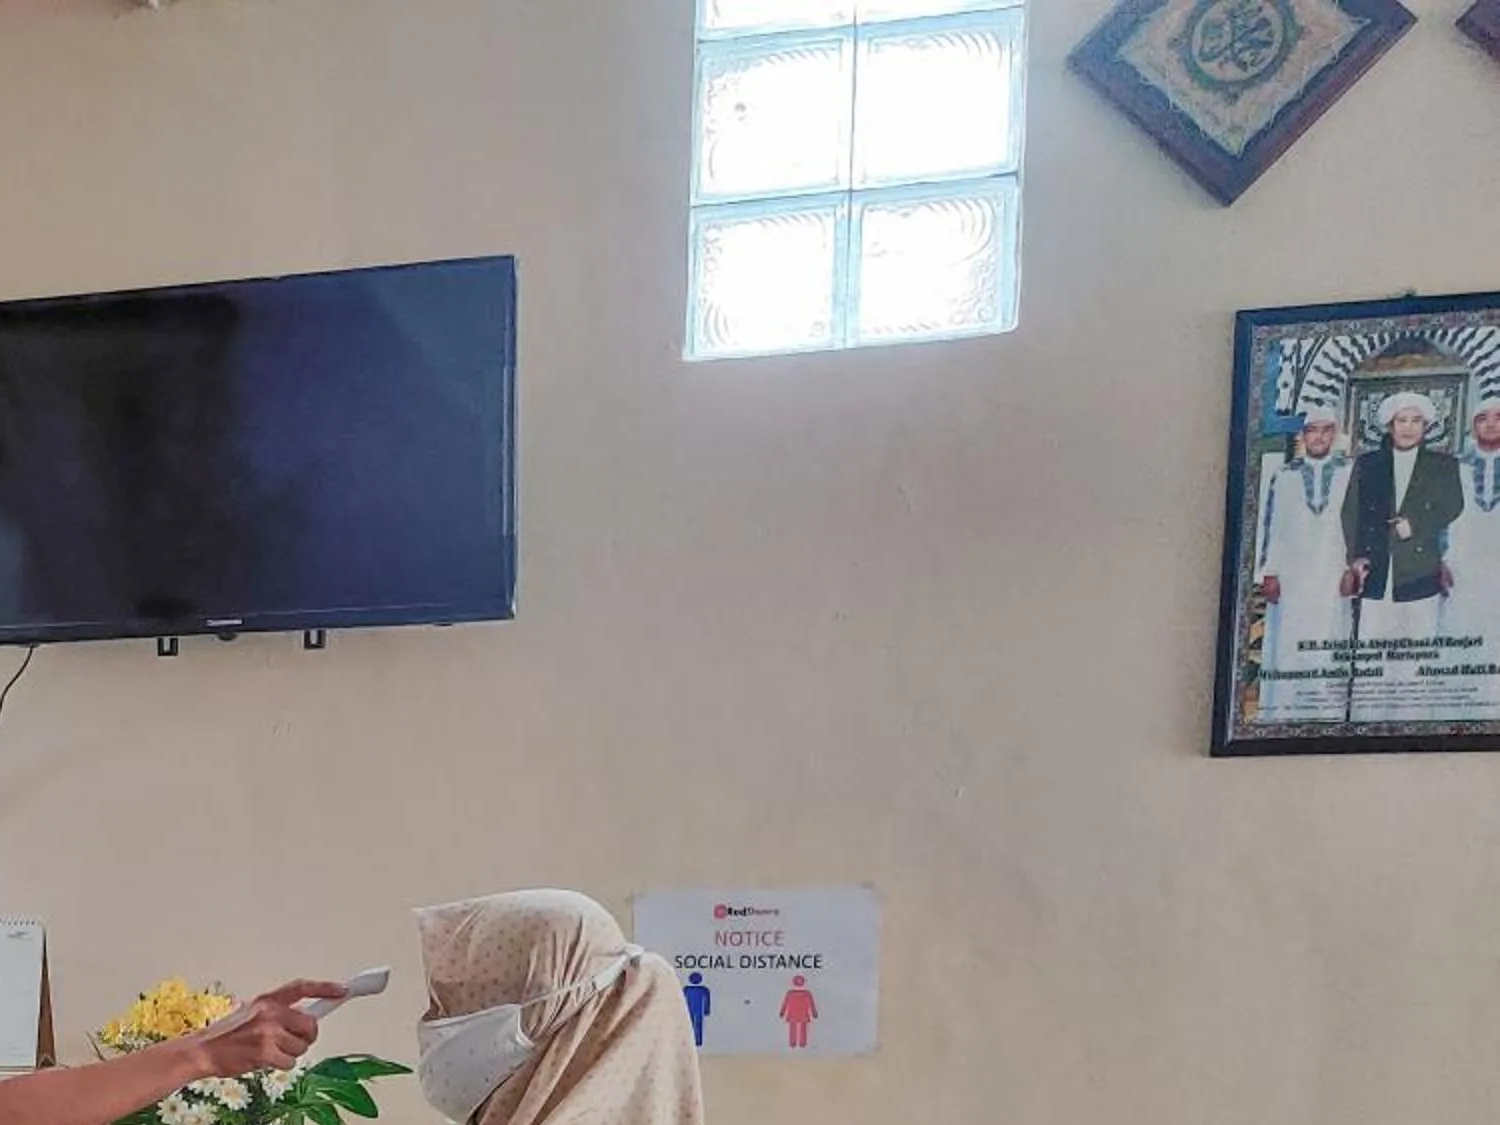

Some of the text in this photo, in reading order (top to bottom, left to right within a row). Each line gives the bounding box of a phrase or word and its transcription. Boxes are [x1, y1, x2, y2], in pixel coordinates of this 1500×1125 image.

[715, 931, 785, 947] NOTICE
[675, 954, 822, 969] SOCIAL DISTANCE
